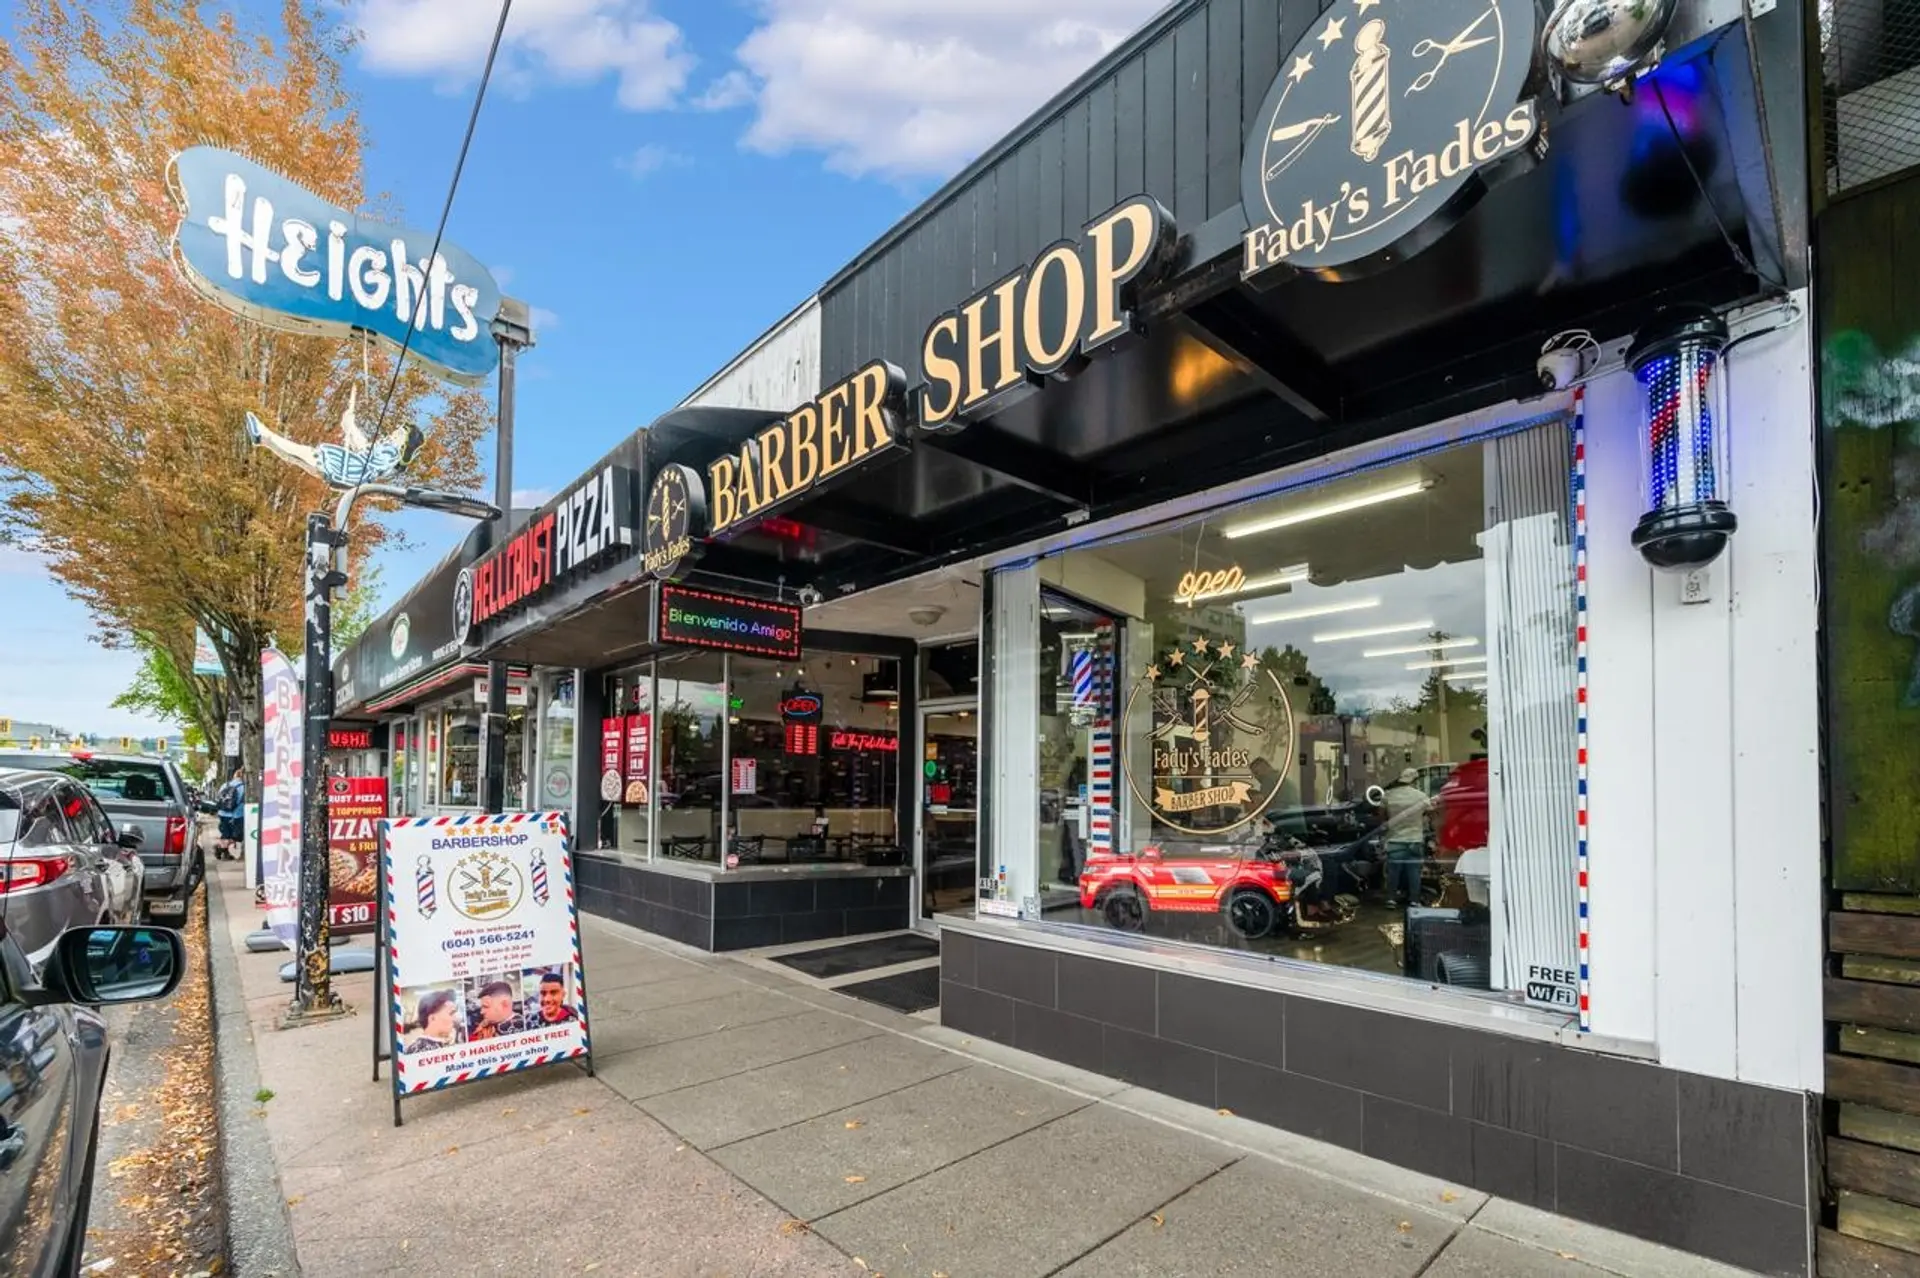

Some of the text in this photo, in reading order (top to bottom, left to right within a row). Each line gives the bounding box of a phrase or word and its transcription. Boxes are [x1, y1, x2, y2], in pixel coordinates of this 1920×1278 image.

[1242, 102, 1535, 274] Fady's Fades
[207, 173, 480, 342] Heights
[708, 202, 1155, 534] BARBER SHOP
[471, 512, 556, 626] HELLCRUST
[1177, 565, 1246, 608] open
[668, 607, 792, 641] Bienvenido Amigo
[1153, 746, 1249, 775] Fady's Fades
[355, 793, 383, 803] PIZZA
[1171, 787, 1236, 811] BARBER SHOP
[431, 833, 529, 850] BARBERSHOP
[441, 937, 475, 952] (604)
[480, 930, 535, 945] 566-5241
[1529, 965, 1576, 985] FREE
[418, 1028, 571, 1067] EVERY 9 HAIRCUT ONE FREE
[445, 1044, 549, 1074] Make this your shop
